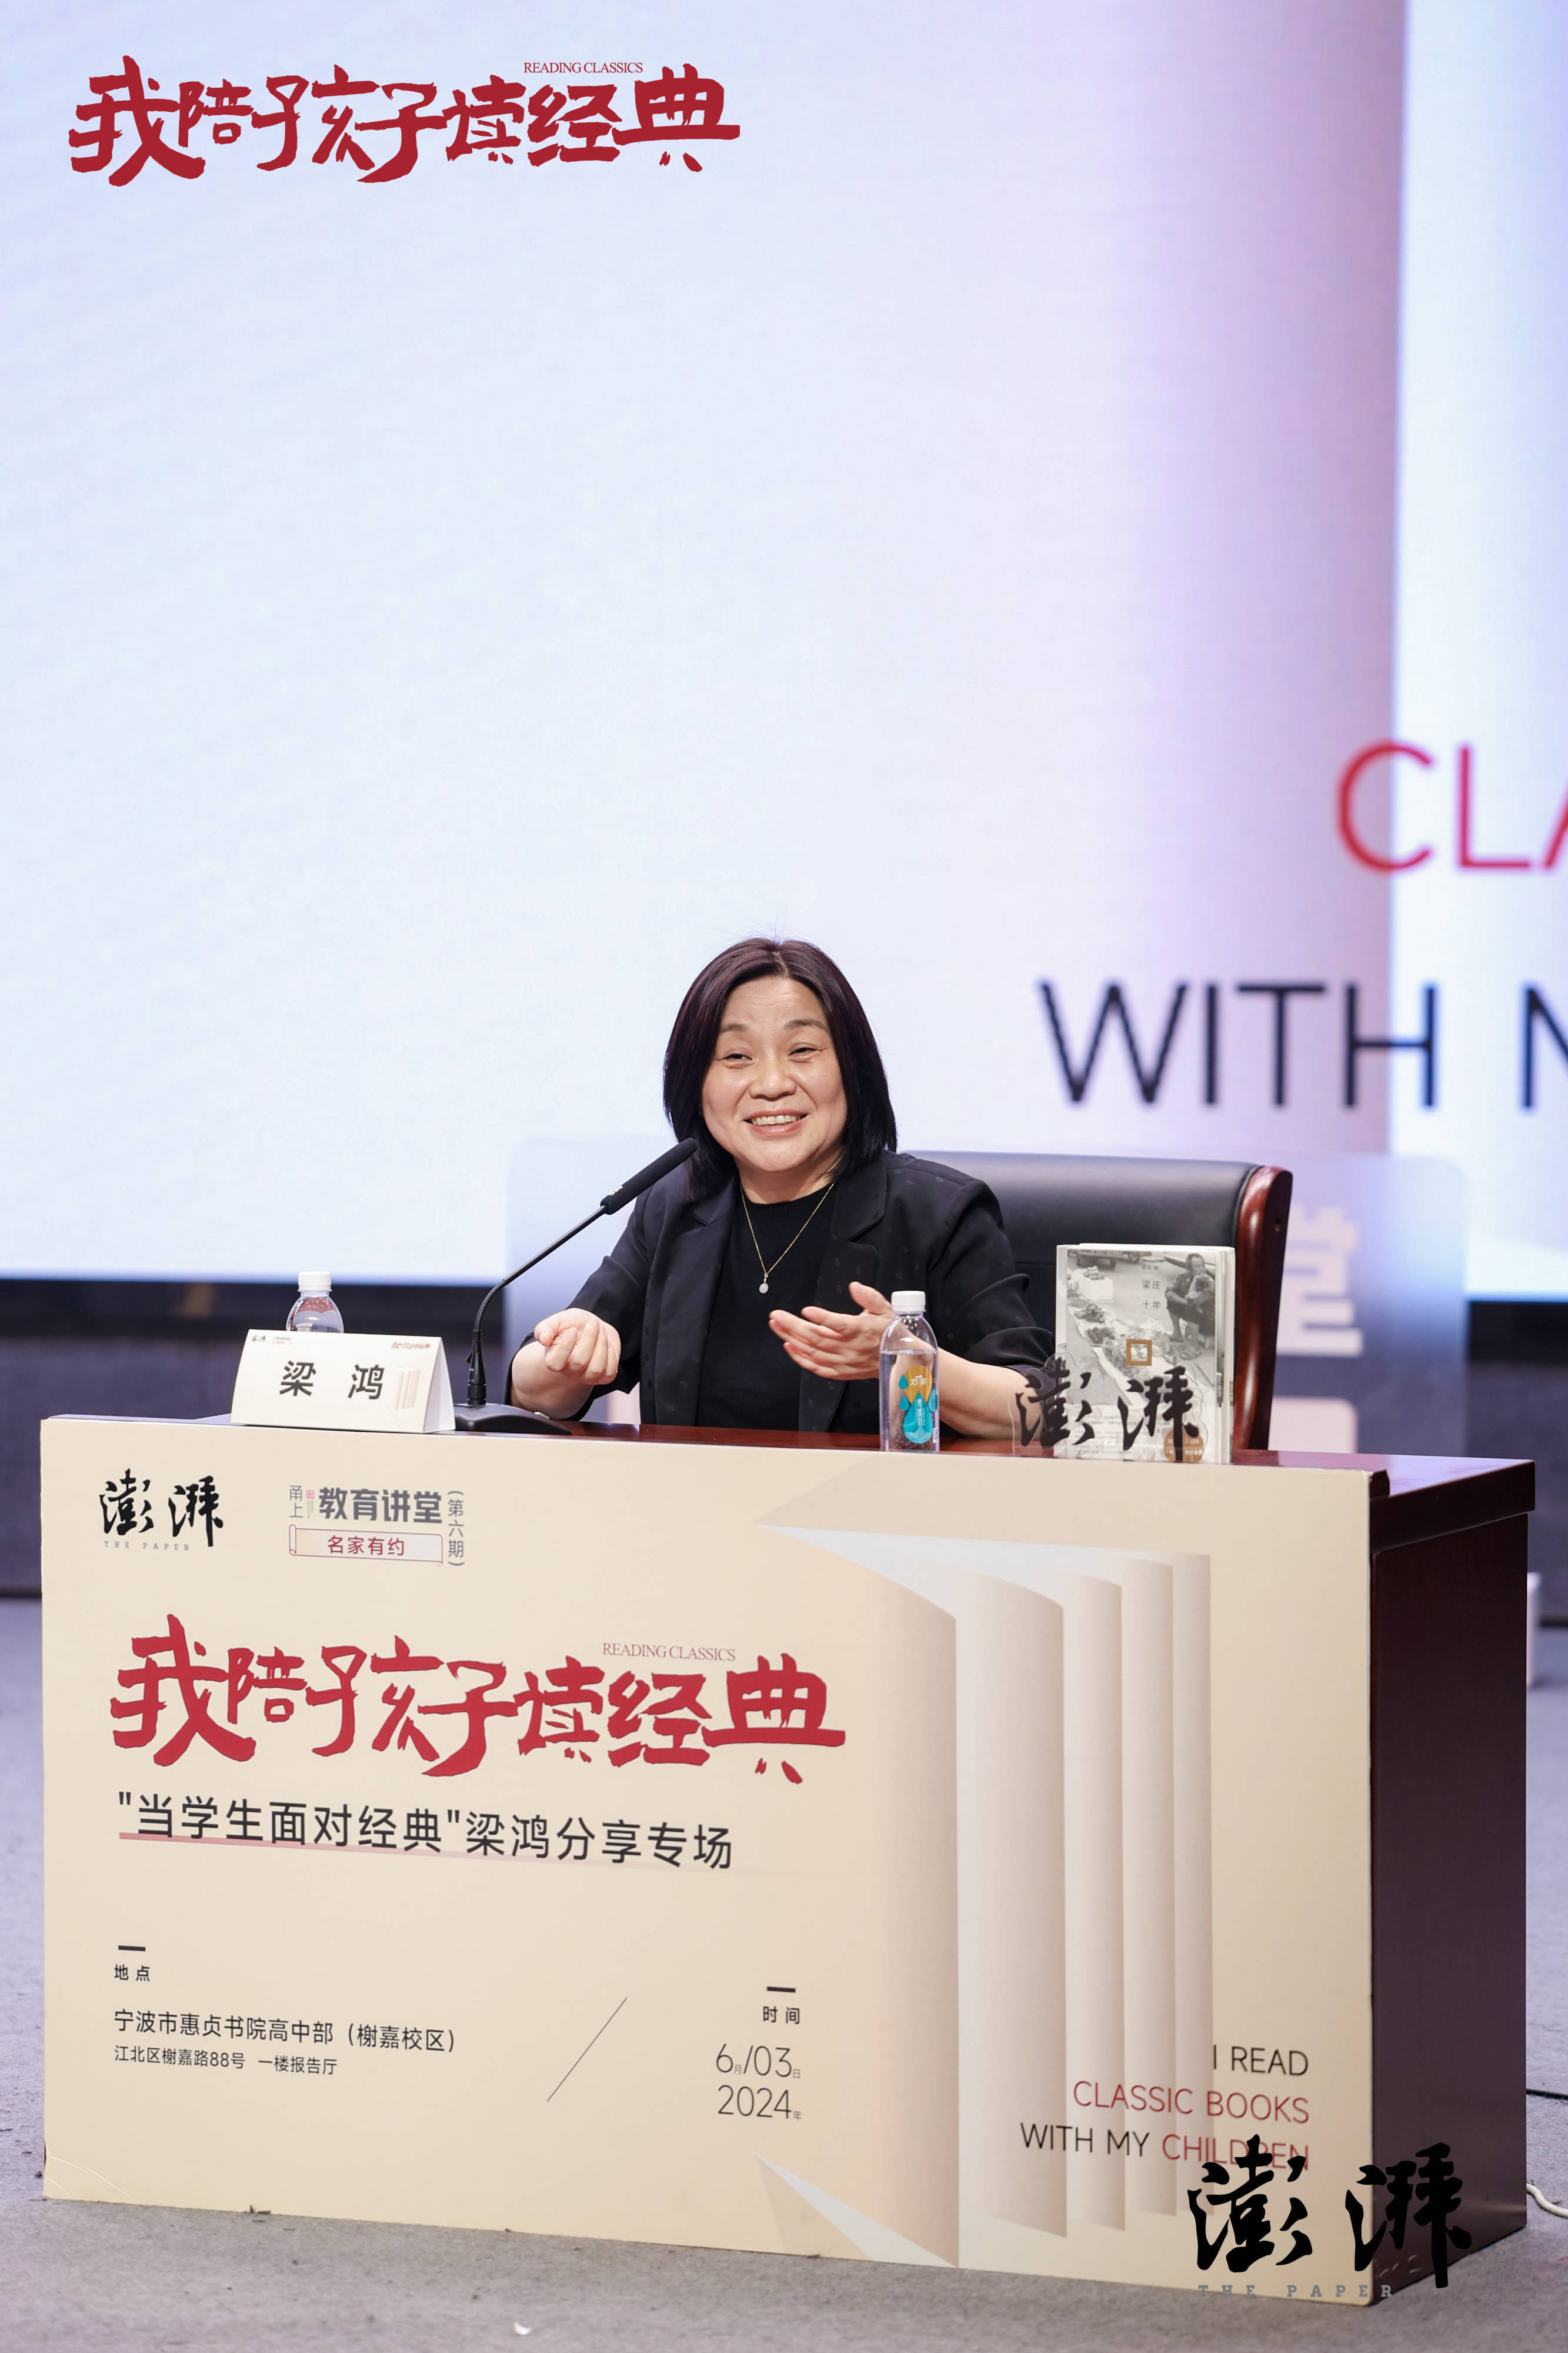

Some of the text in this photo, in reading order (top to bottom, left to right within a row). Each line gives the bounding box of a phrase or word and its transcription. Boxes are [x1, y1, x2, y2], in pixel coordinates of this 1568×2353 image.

[1042, 982, 1436, 1108] WITH
[1142, 1299, 1162, 1309] 十年
[1015, 1356, 1200, 1464] 澎湃
[99, 1468, 223, 1547] 澎湃
[289, 1485, 303, 1518] 甬上
[318, 1487, 443, 1524] 教育讲堂
[104, 1541, 189, 1551] THE PAPER
[327, 1534, 405, 1556] 名家有约
[603, 1642, 736, 1661] READING CLASSICS
[110, 1614, 846, 1784] 我陪孩子读经典
[114, 1964, 151, 1982] 地点
[762, 2005, 800, 2025] 时间
[114, 2045, 338, 2075] 江北区榭嘉路88号 一楼报告厅
[1213, 2044, 1309, 2077] I READ
[718, 2084, 802, 2121] 2024年
[1073, 2079, 1310, 2124] CLASSIC BOOKS
[1019, 2122, 1093, 2154] WITH
[1106, 2129, 1150, 2158] MY
